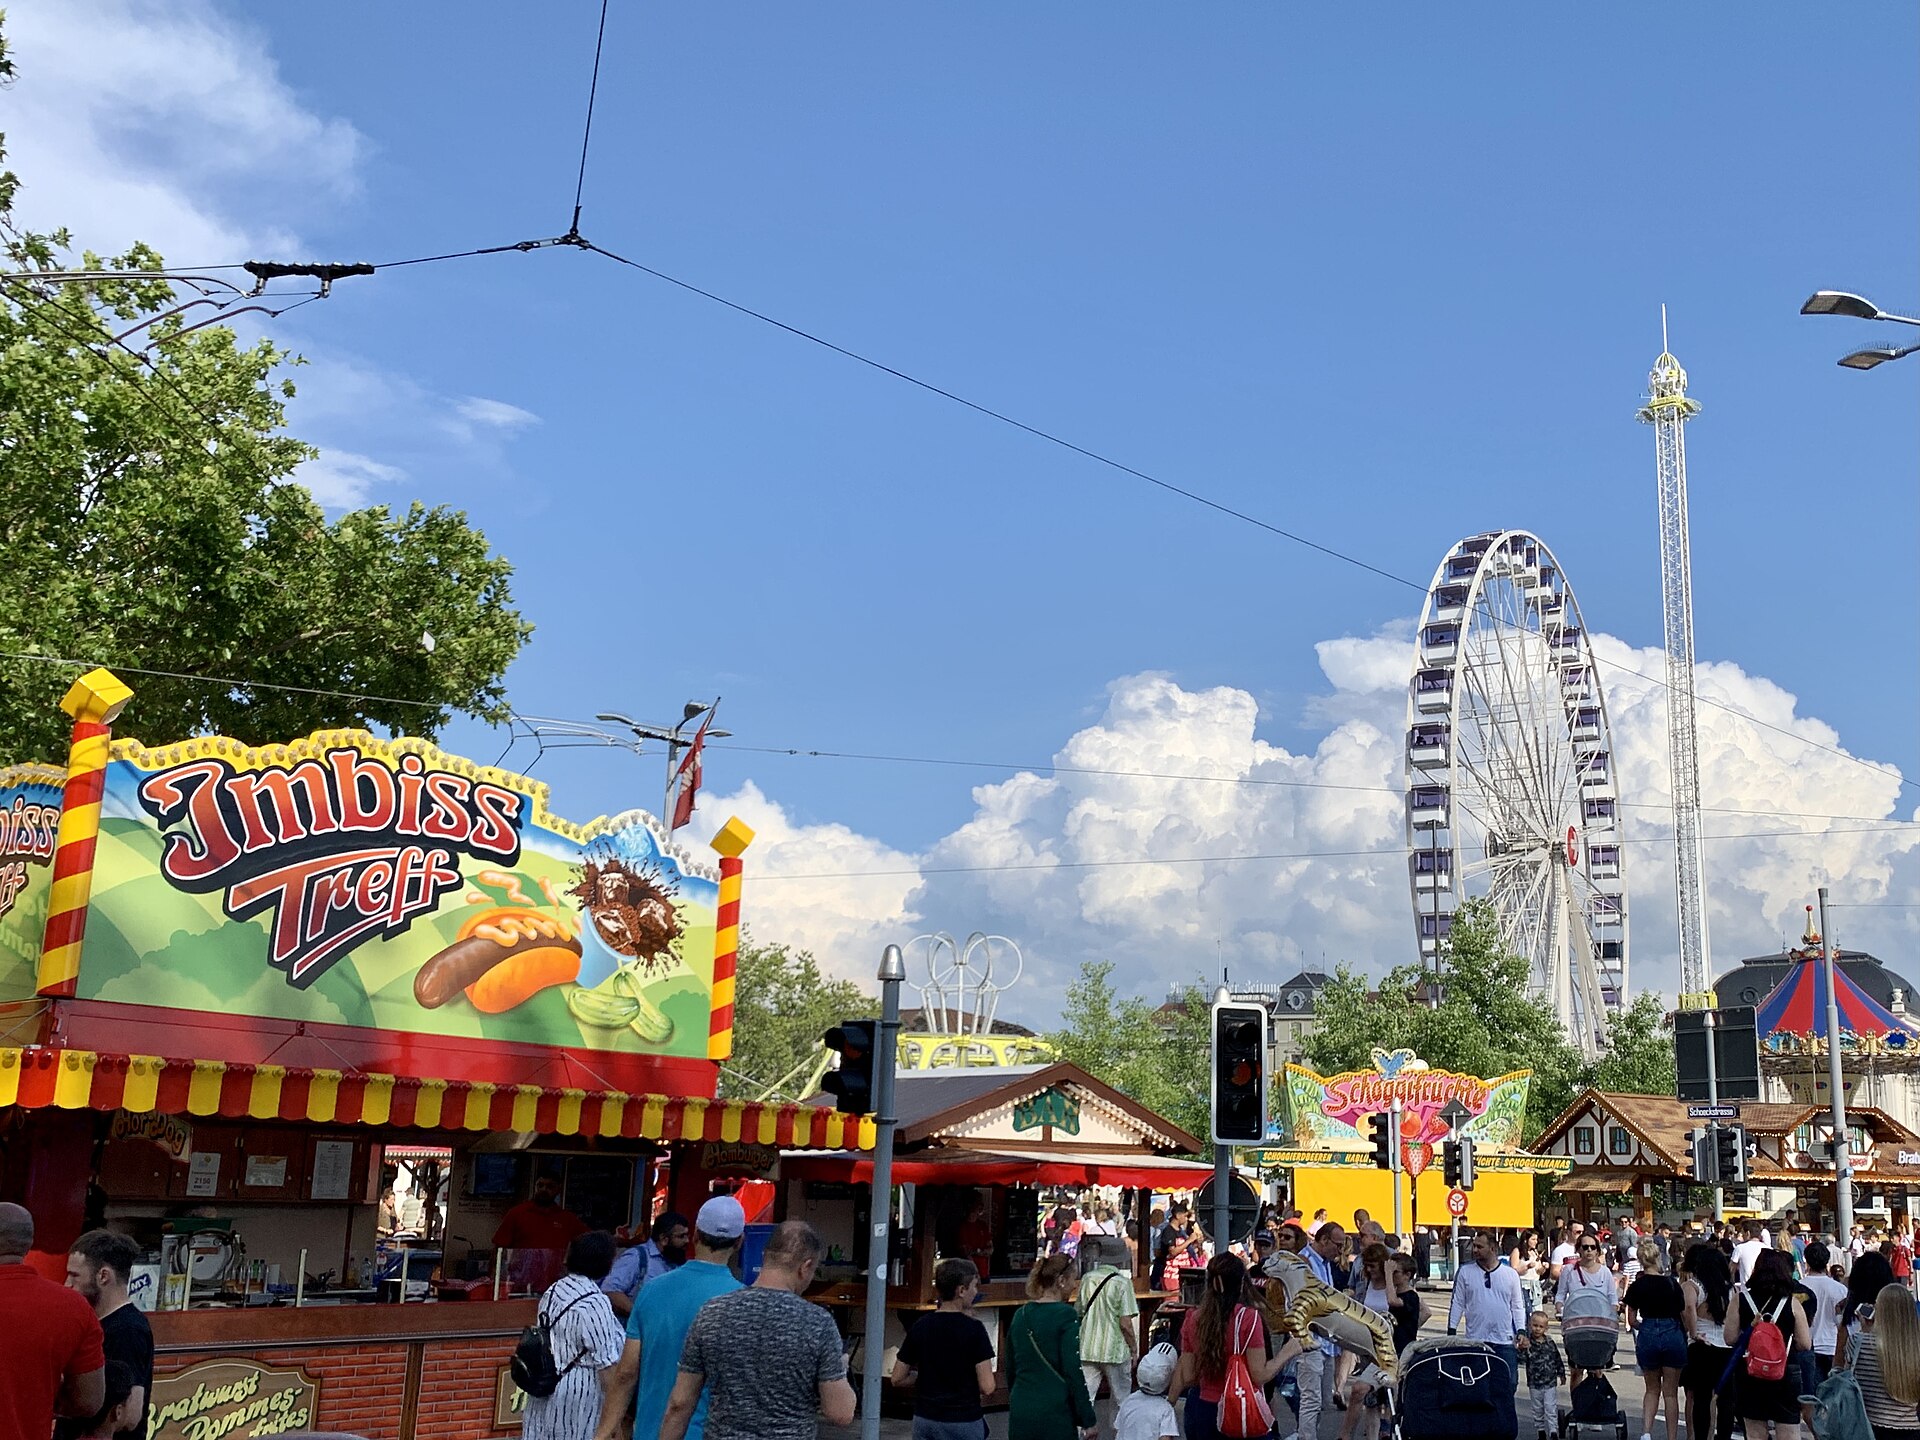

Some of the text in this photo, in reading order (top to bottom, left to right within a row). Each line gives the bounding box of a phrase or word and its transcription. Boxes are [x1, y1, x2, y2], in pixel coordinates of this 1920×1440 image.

[0, 797, 60, 859] iss
[229, 845, 458, 976] Treff
[1262, 1151, 1332, 1162] SCHOGGIERDBEEREN
[1503, 1157, 1571, 1169] SCHOGGIANANAS
